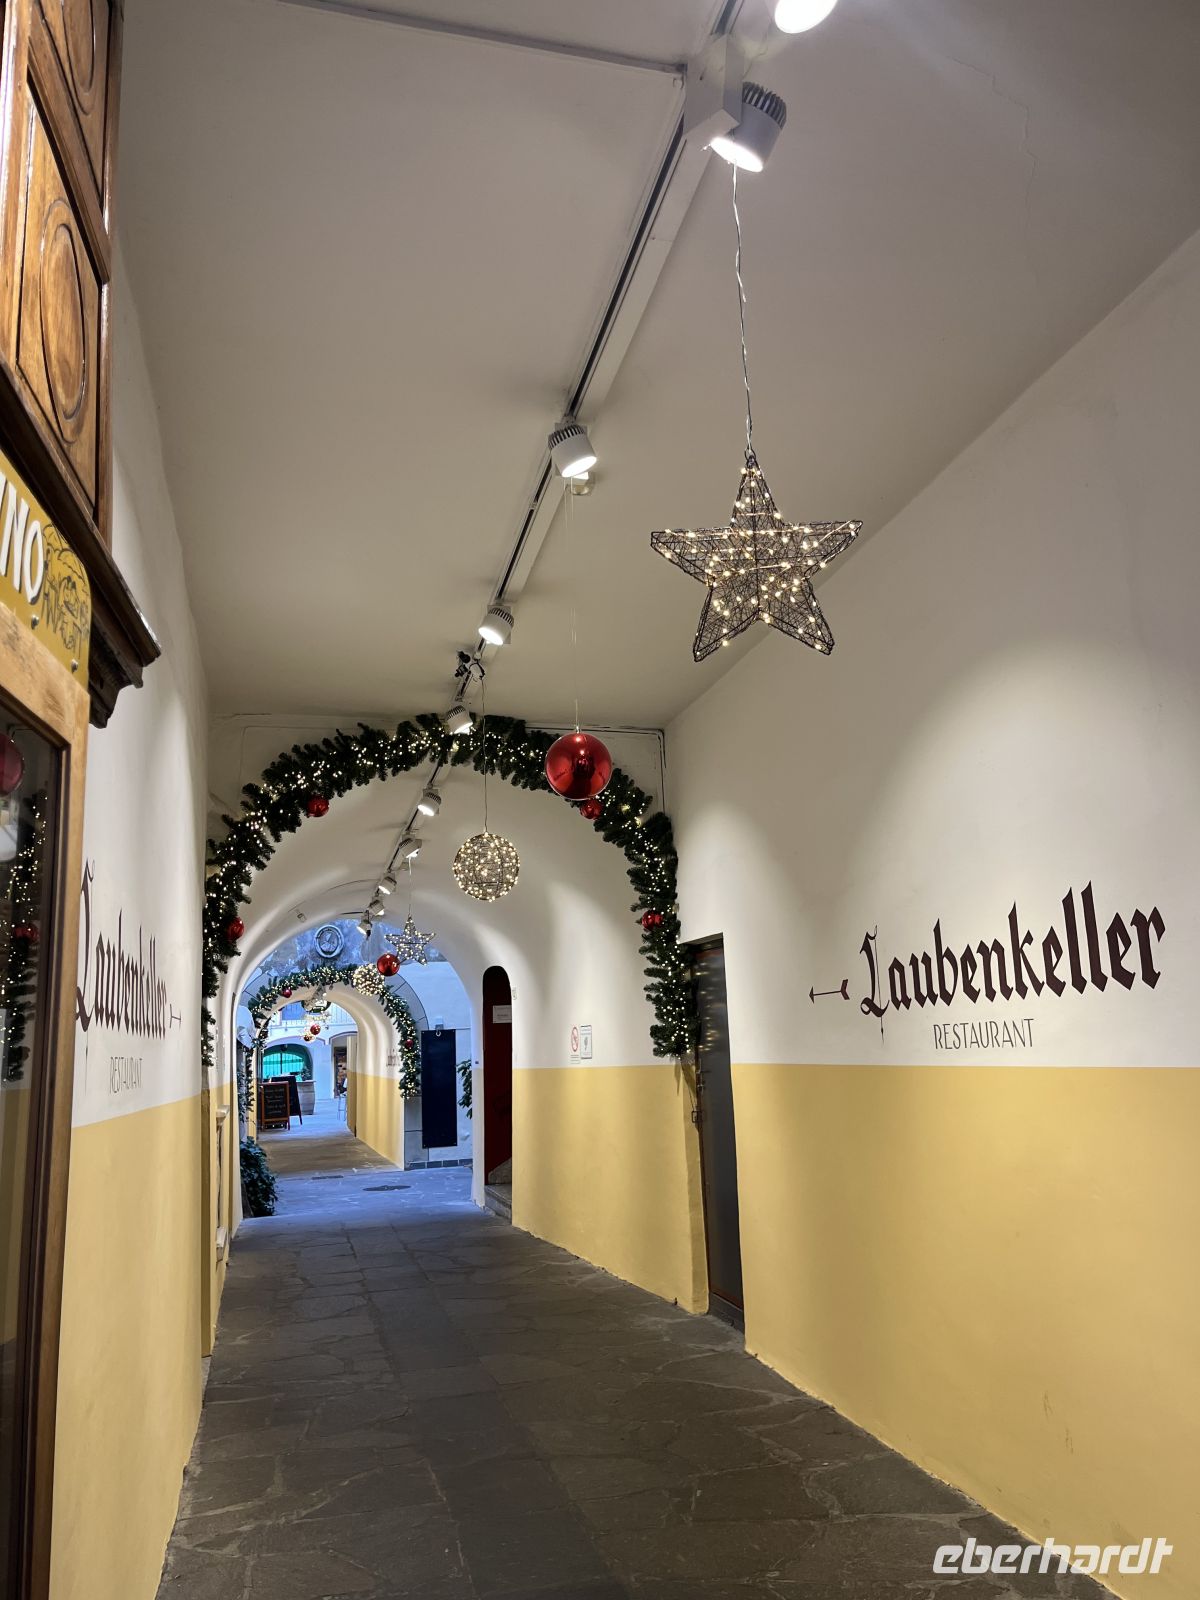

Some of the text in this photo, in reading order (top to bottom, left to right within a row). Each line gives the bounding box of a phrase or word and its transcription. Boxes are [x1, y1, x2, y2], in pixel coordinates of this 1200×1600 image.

[76, 857, 167, 1040] Laubenkeller
[859, 880, 1166, 1020] Laubenkeller
[109, 1055, 144, 1095] RESTAURANT
[934, 1018, 1034, 1050] RESTAURANT
